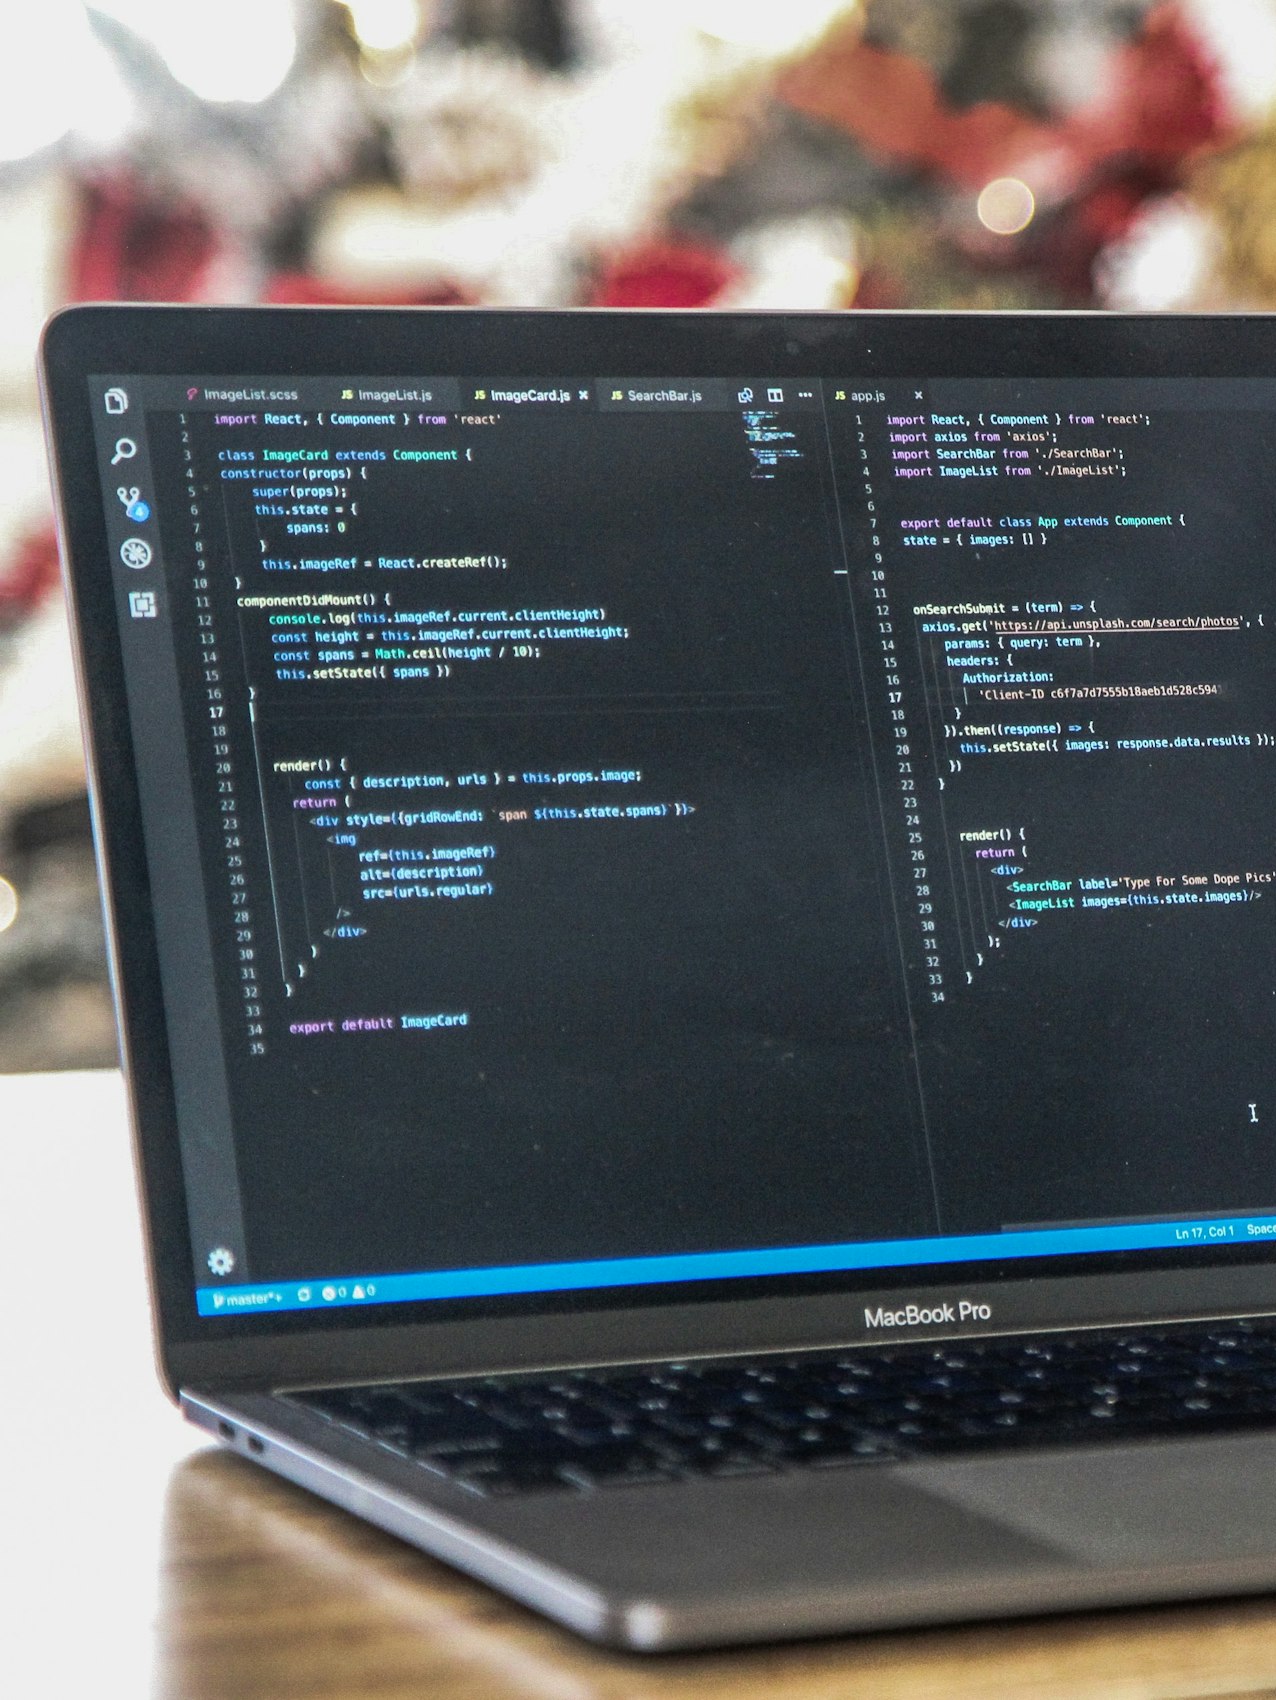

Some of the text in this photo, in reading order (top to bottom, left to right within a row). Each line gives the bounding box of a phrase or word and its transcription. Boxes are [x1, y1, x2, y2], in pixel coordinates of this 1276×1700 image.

[204, 389, 299, 403] ImageList.scss
[358, 389, 433, 403] ImageList.js
[490, 389, 571, 404] ImageCard.js
[627, 389, 703, 403] SearchBar.js
[851, 389, 886, 403] app.js
[214, 412, 501, 427] import React, Component from 'react'
[887, 413, 1150, 428] import React, Component from 'react';
[889, 430, 1057, 445] import axios from 'axios';
[218, 449, 458, 463] class ImageCard extends Component
[891, 447, 1124, 462] import SearchBar from './SearchBar';
[220, 467, 352, 482] constructor(props)
[894, 464, 1126, 479] import ImageList from './ImageList';
[252, 485, 347, 500] super(props);
[255, 504, 329, 516] this.state
[286, 523, 329, 536] spans:
[900, 515, 1173, 531] export default class App extends Component
[903, 534, 1014, 548] state images:
[262, 555, 507, 572] this.imageRef React.createRef();
[871, 570, 885, 581] 10
[873, 587, 887, 599] 11
[196, 596, 210, 608] 11
[236, 593, 376, 609] componentDidMount()
[876, 604, 890, 616] 12
[912, 601, 1063, 616] onSearchSubmit (term)
[198, 614, 212, 626] 12
[268, 608, 606, 627] console.log(this.imageRef.current.clientHeight)
[878, 622, 893, 634] 13
[200, 633, 215, 645] 13
[271, 625, 629, 645] const height this.imageRef.current.clientHeight;
[881, 639, 895, 651] 14
[945, 636, 1083, 651] params: query: term
[202, 651, 217, 663] 14
[273, 644, 541, 663] const spans Math.ceil(height 10);
[883, 657, 898, 668] 15
[946, 655, 1000, 667] headers:
[205, 669, 219, 682] 15
[393, 667, 430, 680] spans
[886, 674, 900, 686] 16
[962, 671, 1054, 684] Authorization:
[207, 688, 222, 700] 16
[888, 691, 902, 704] 17
[209, 706, 224, 719] 17
[891, 709, 905, 721] 18
[211, 725, 227, 737] 18
[894, 726, 908, 738] 19
[214, 743, 229, 756] 19
[895, 744, 910, 756] 20
[1065, 739, 1110, 753] images:
[1116, 734, 1251, 751] response.data.results
[273, 758, 331, 773] render()
[898, 762, 912, 773] 21
[304, 769, 642, 790] const description, urls this.props.image;
[900, 779, 915, 791] 22
[292, 797, 337, 809] return
[903, 796, 918, 809] 23
[906, 814, 920, 826] 24
[908, 832, 923, 844] 25
[959, 828, 1012, 842] render()
[358, 845, 496, 863] ref={this.imageRef}
[910, 849, 925, 861] 26
[975, 847, 1015, 859] return
[360, 864, 484, 882] alt={description}
[913, 867, 927, 879] 27
[990, 864, 1024, 876] <div>
[1006, 879, 1073, 893] <SearchBar
[1156, 875, 1176, 887] For
[1181, 874, 1208, 886] Some
[1213, 873, 1240, 887] Dope
[1245, 871, 1276, 883] Pics'
[362, 882, 494, 900] src={urls.regular}
[1009, 897, 1075, 912] <ImageList
[998, 916, 1038, 929] </div>
[323, 925, 367, 938] </div>
[289, 1013, 468, 1036] export default ImageCard
[1175, 1229, 1190, 1240] Ln
[1191, 1226, 1207, 1240] 17,
[1208, 1225, 1227, 1238] Col
[864, 1300, 992, 1328] MacBook Pro
